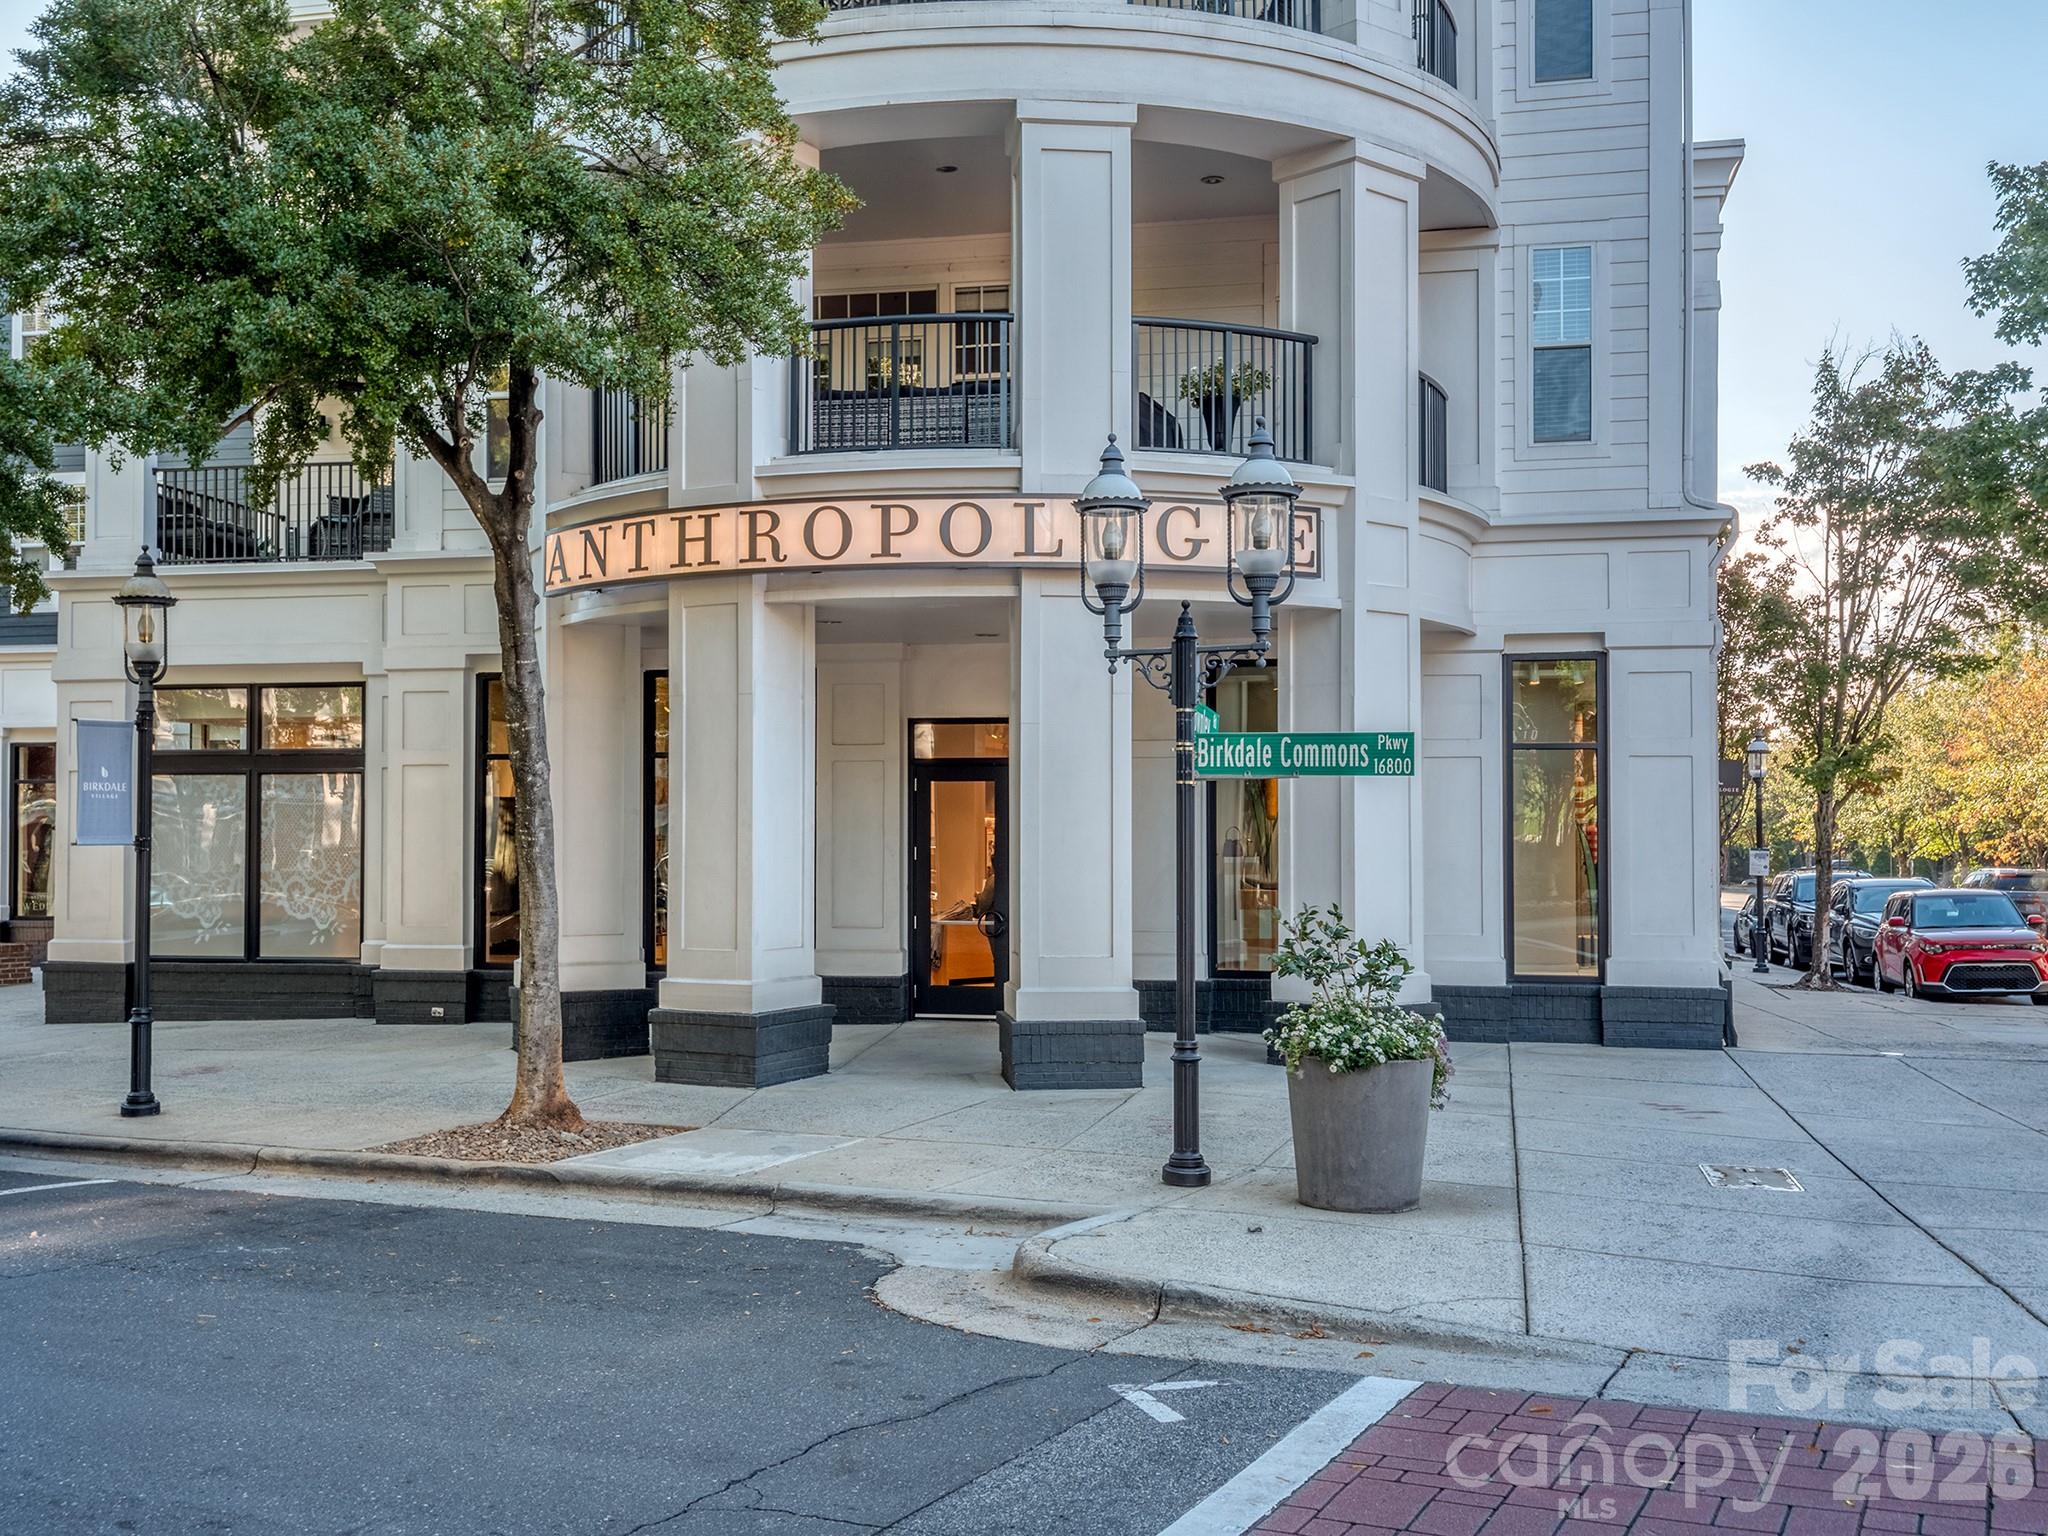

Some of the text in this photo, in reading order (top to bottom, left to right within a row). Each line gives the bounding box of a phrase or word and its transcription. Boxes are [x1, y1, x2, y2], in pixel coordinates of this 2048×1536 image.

[1197, 734, 1408, 768] Birkdale Commons Pkwy
[1373, 757, 1412, 775] 16800
[83, 782, 127, 792] BIRKDALE
